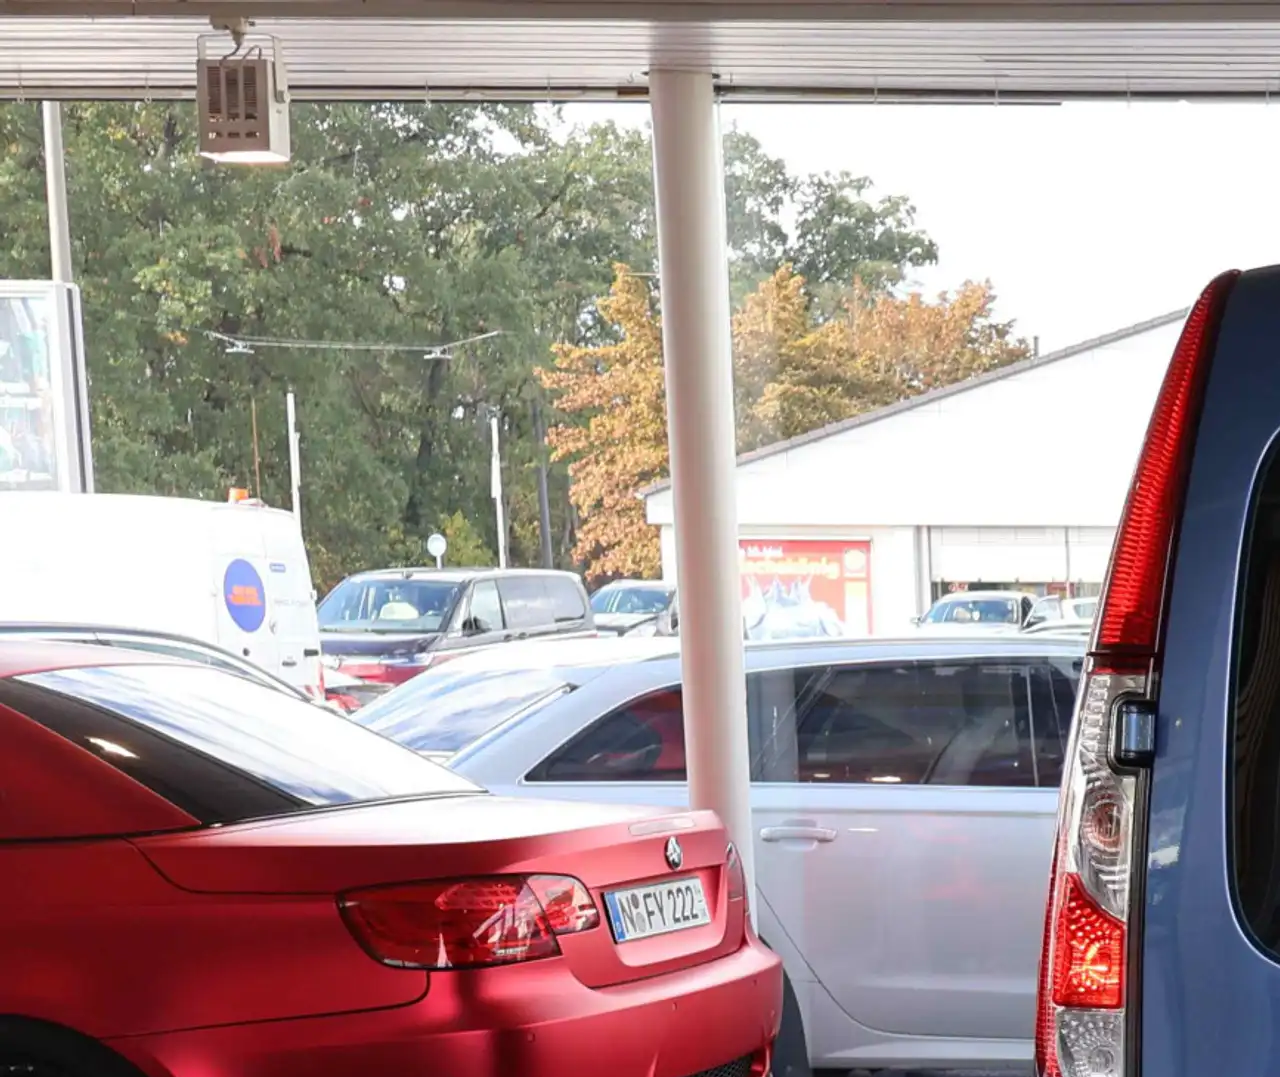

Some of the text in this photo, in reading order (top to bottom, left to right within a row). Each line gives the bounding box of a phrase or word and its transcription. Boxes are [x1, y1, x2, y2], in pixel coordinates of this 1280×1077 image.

[618, 885, 699, 933] N FY 222
